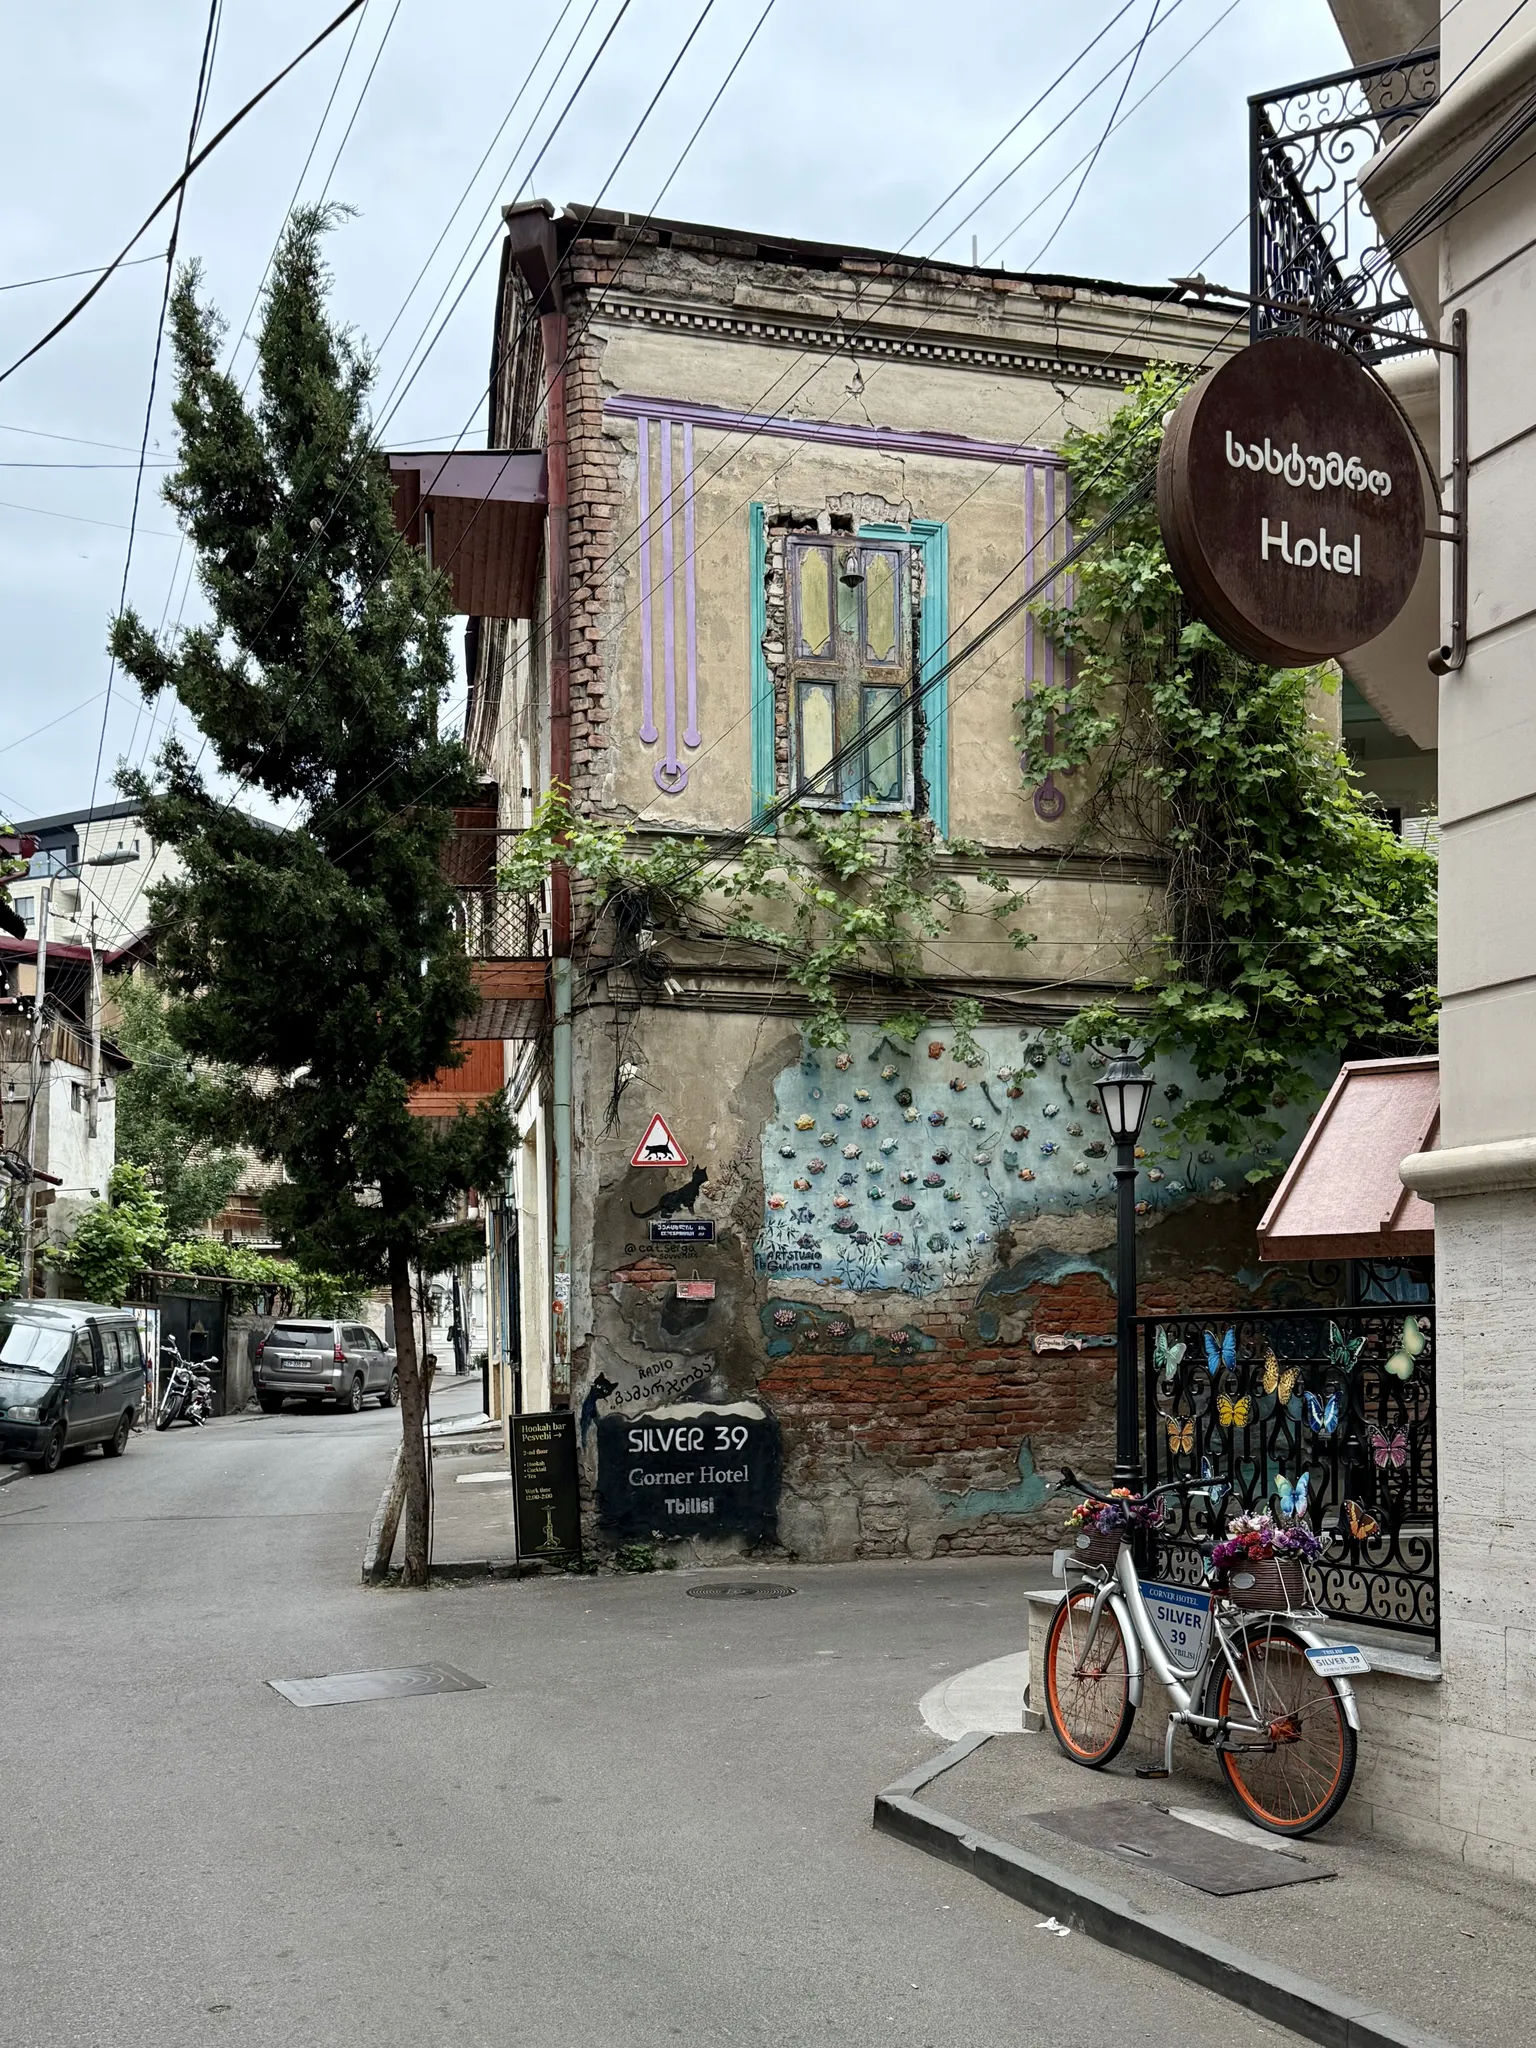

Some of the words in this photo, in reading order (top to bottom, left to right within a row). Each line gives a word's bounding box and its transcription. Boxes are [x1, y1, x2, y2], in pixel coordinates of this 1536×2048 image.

[1225, 429, 1392, 497] სასტუმრო
[1261, 517, 1361, 577] Hotel
[628, 1427, 704, 1453] SILVER
[714, 1425, 749, 1451] 39
[699, 1464, 749, 1484] Hotel
[664, 1497, 715, 1515] Tbilisi
[1157, 1606, 1202, 1629] SILVER
[1170, 1629, 1187, 1645] 39
[1316, 1657, 1347, 1666] SILVER
[1348, 1656, 1360, 1664] 39
